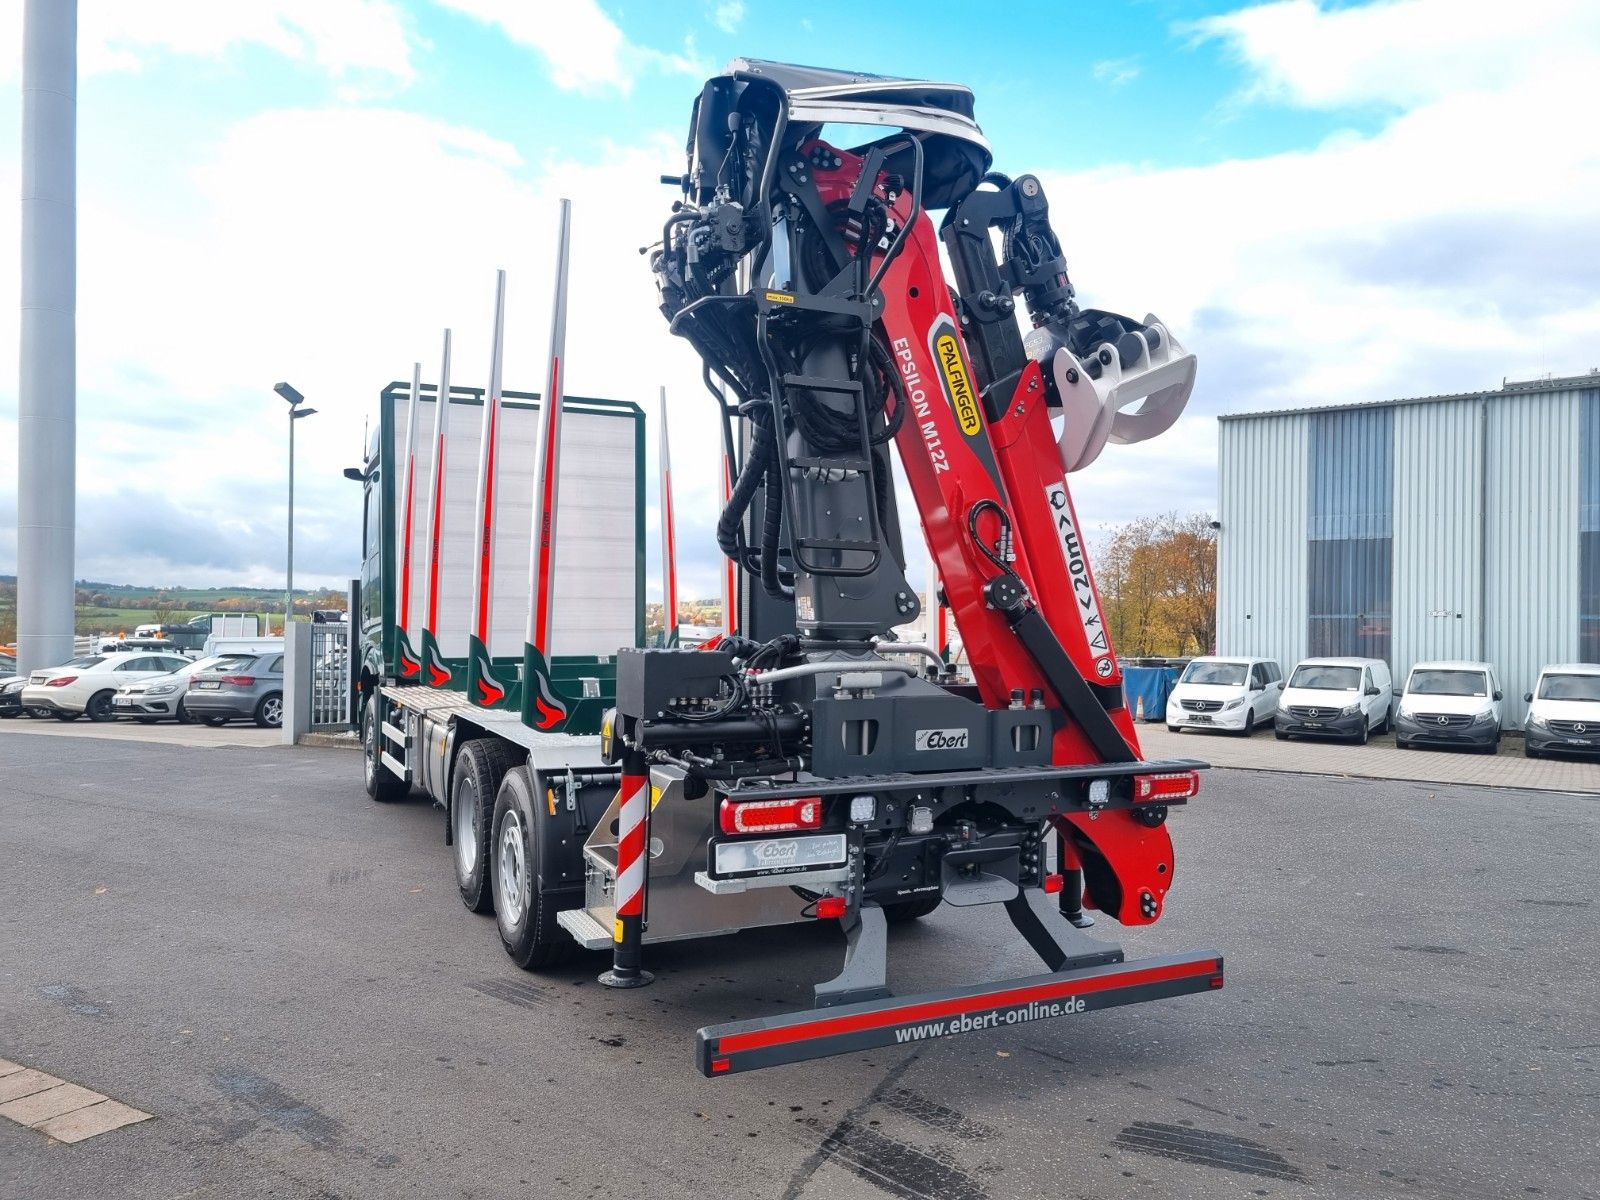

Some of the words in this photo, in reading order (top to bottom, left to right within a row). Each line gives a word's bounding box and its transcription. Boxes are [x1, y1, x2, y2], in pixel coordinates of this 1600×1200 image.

[893, 337, 931, 418] EPSILON
[921, 421, 950, 475] M12Z
[940, 340, 977, 430] PALFINGER
[927, 731, 967, 749] Ebert
[763, 842, 797, 858] Ebert
[895, 995, 1086, 1043] www.ebert-online.de
